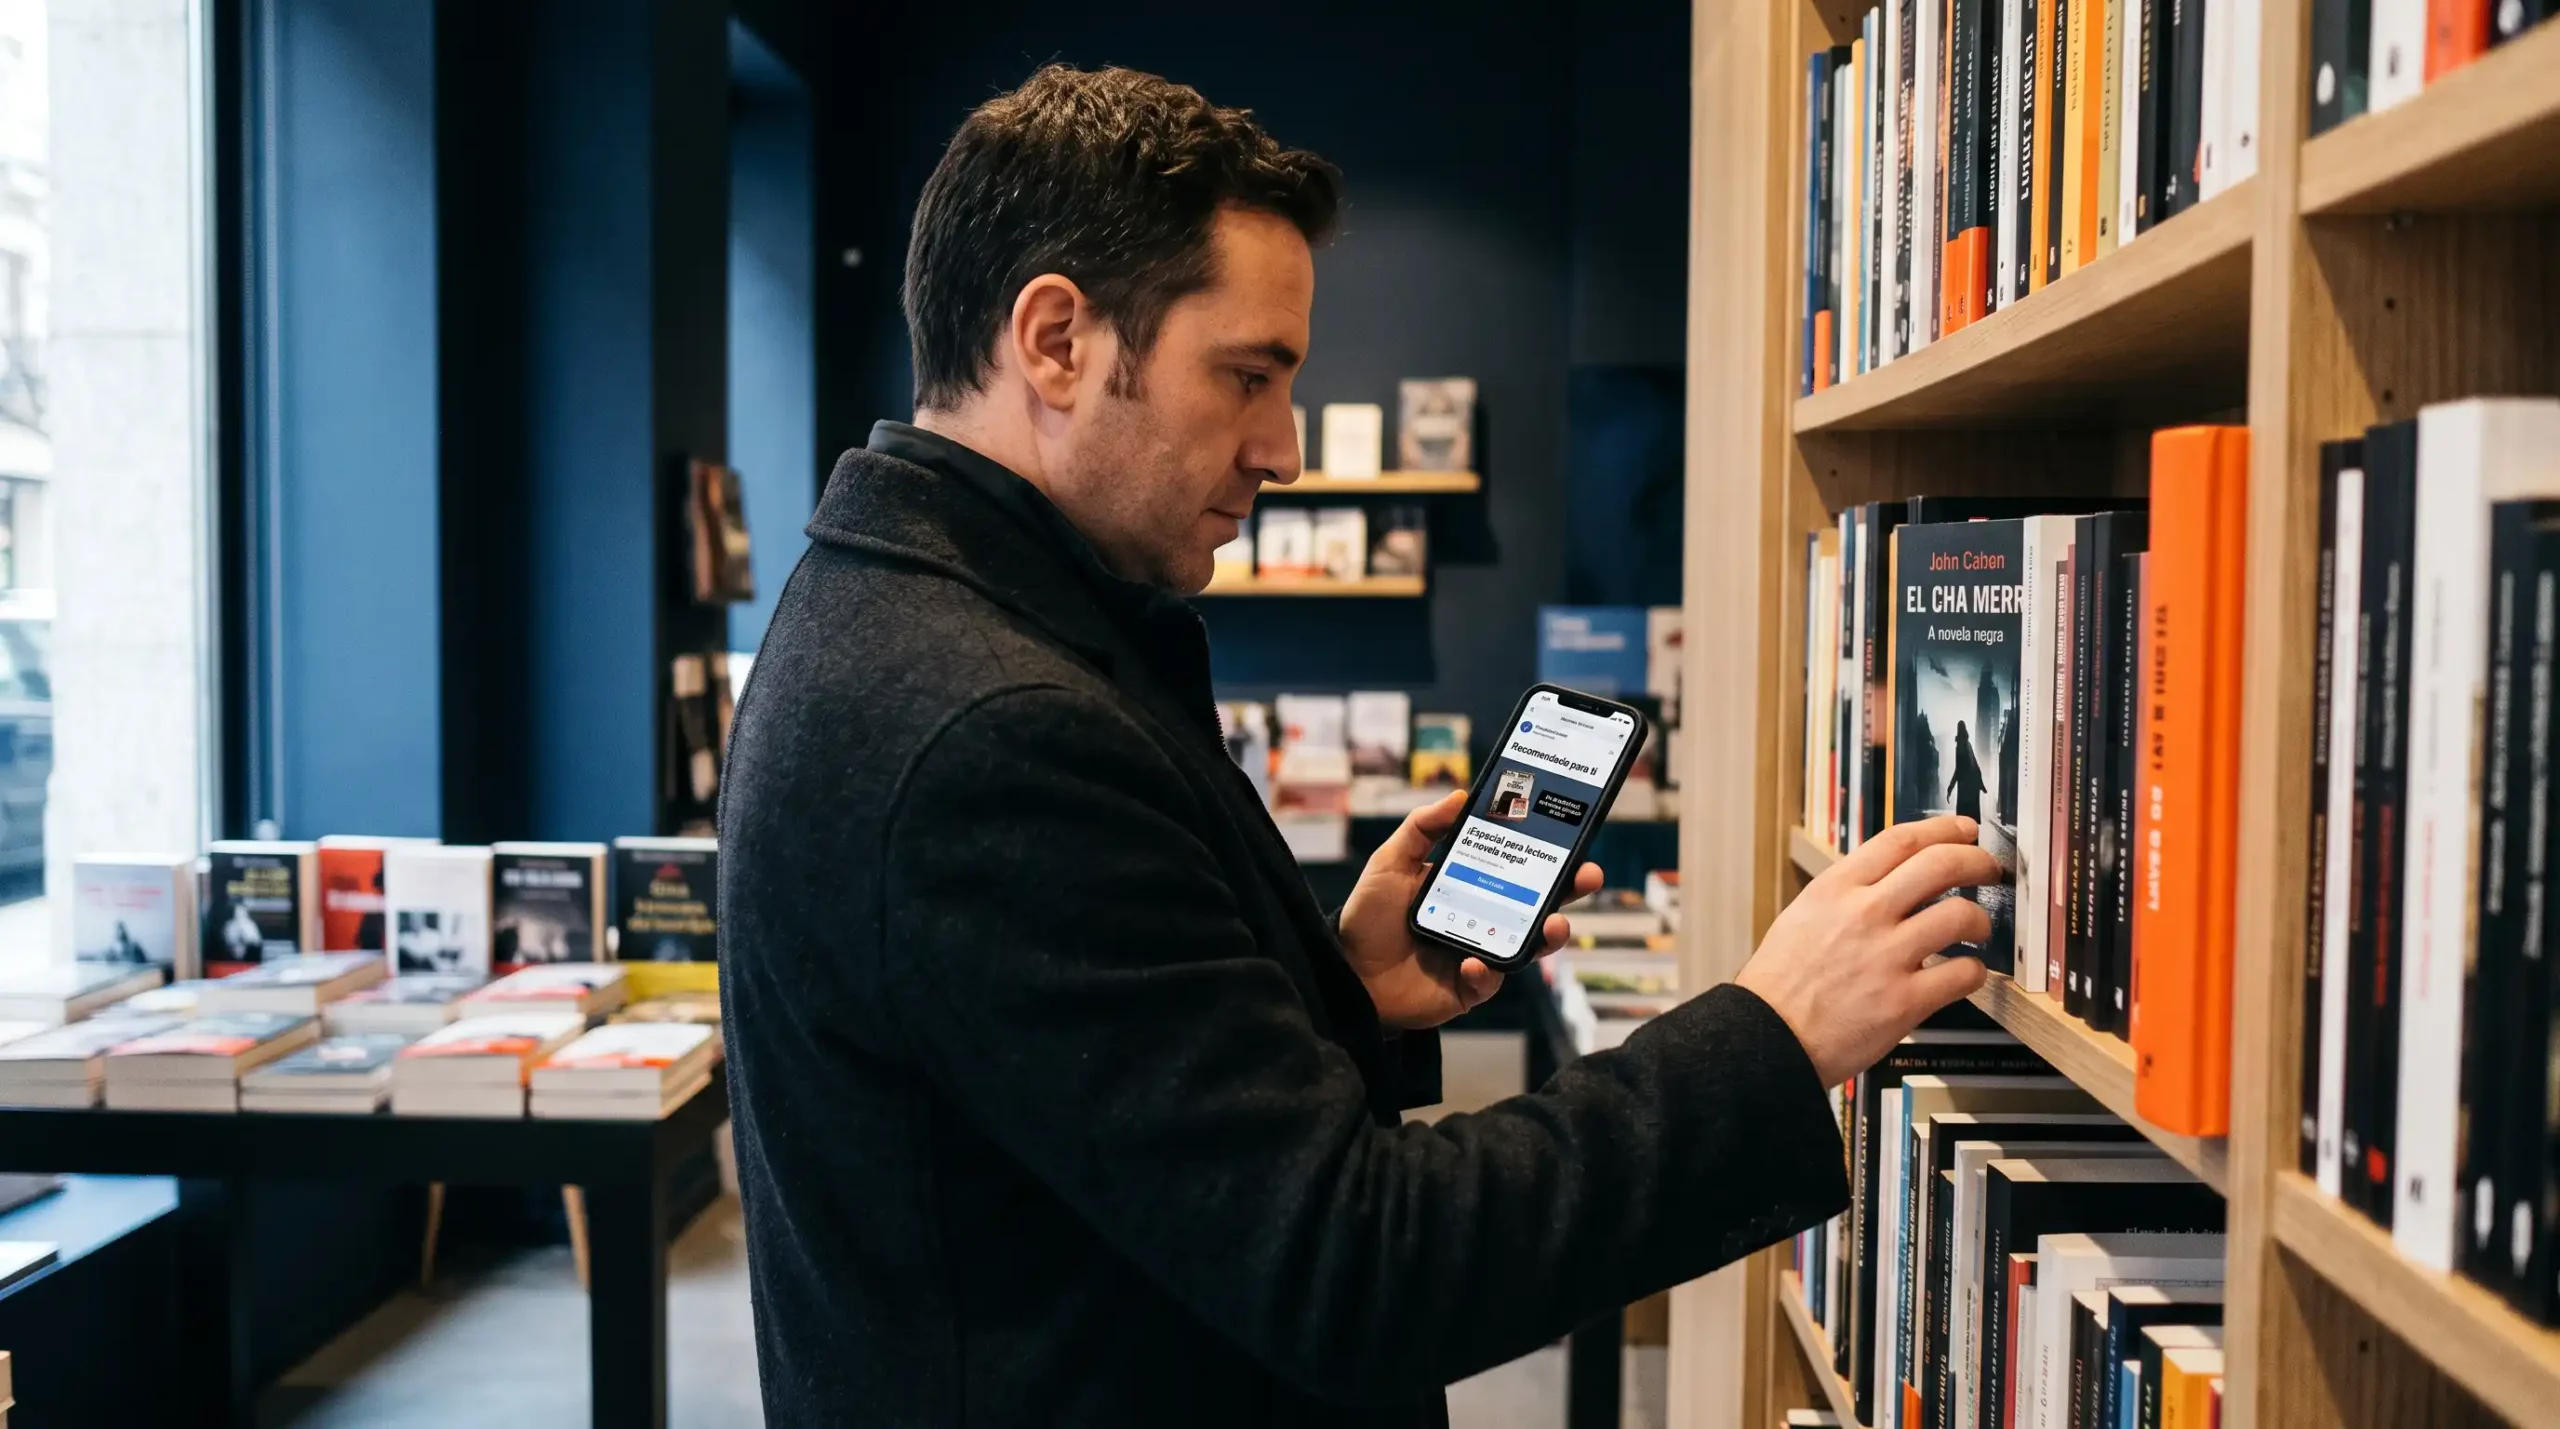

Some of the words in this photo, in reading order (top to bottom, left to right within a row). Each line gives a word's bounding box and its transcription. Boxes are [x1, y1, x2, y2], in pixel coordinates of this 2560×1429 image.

[1930, 551, 1959, 571] John
[1907, 585, 1926, 613] EL
[1932, 585, 1968, 613] CHA
[1973, 585, 2024, 613] MERR
[1928, 625, 1936, 641] A
[1938, 625, 1971, 641] novela
[1973, 629, 2004, 646] negra
[1568, 762, 1589, 774] para
[1590, 767, 1598, 776] ti
[1461, 836, 1473, 846] de
[1473, 841, 1500, 856] novela
[1525, 845, 1558, 863] lectores
